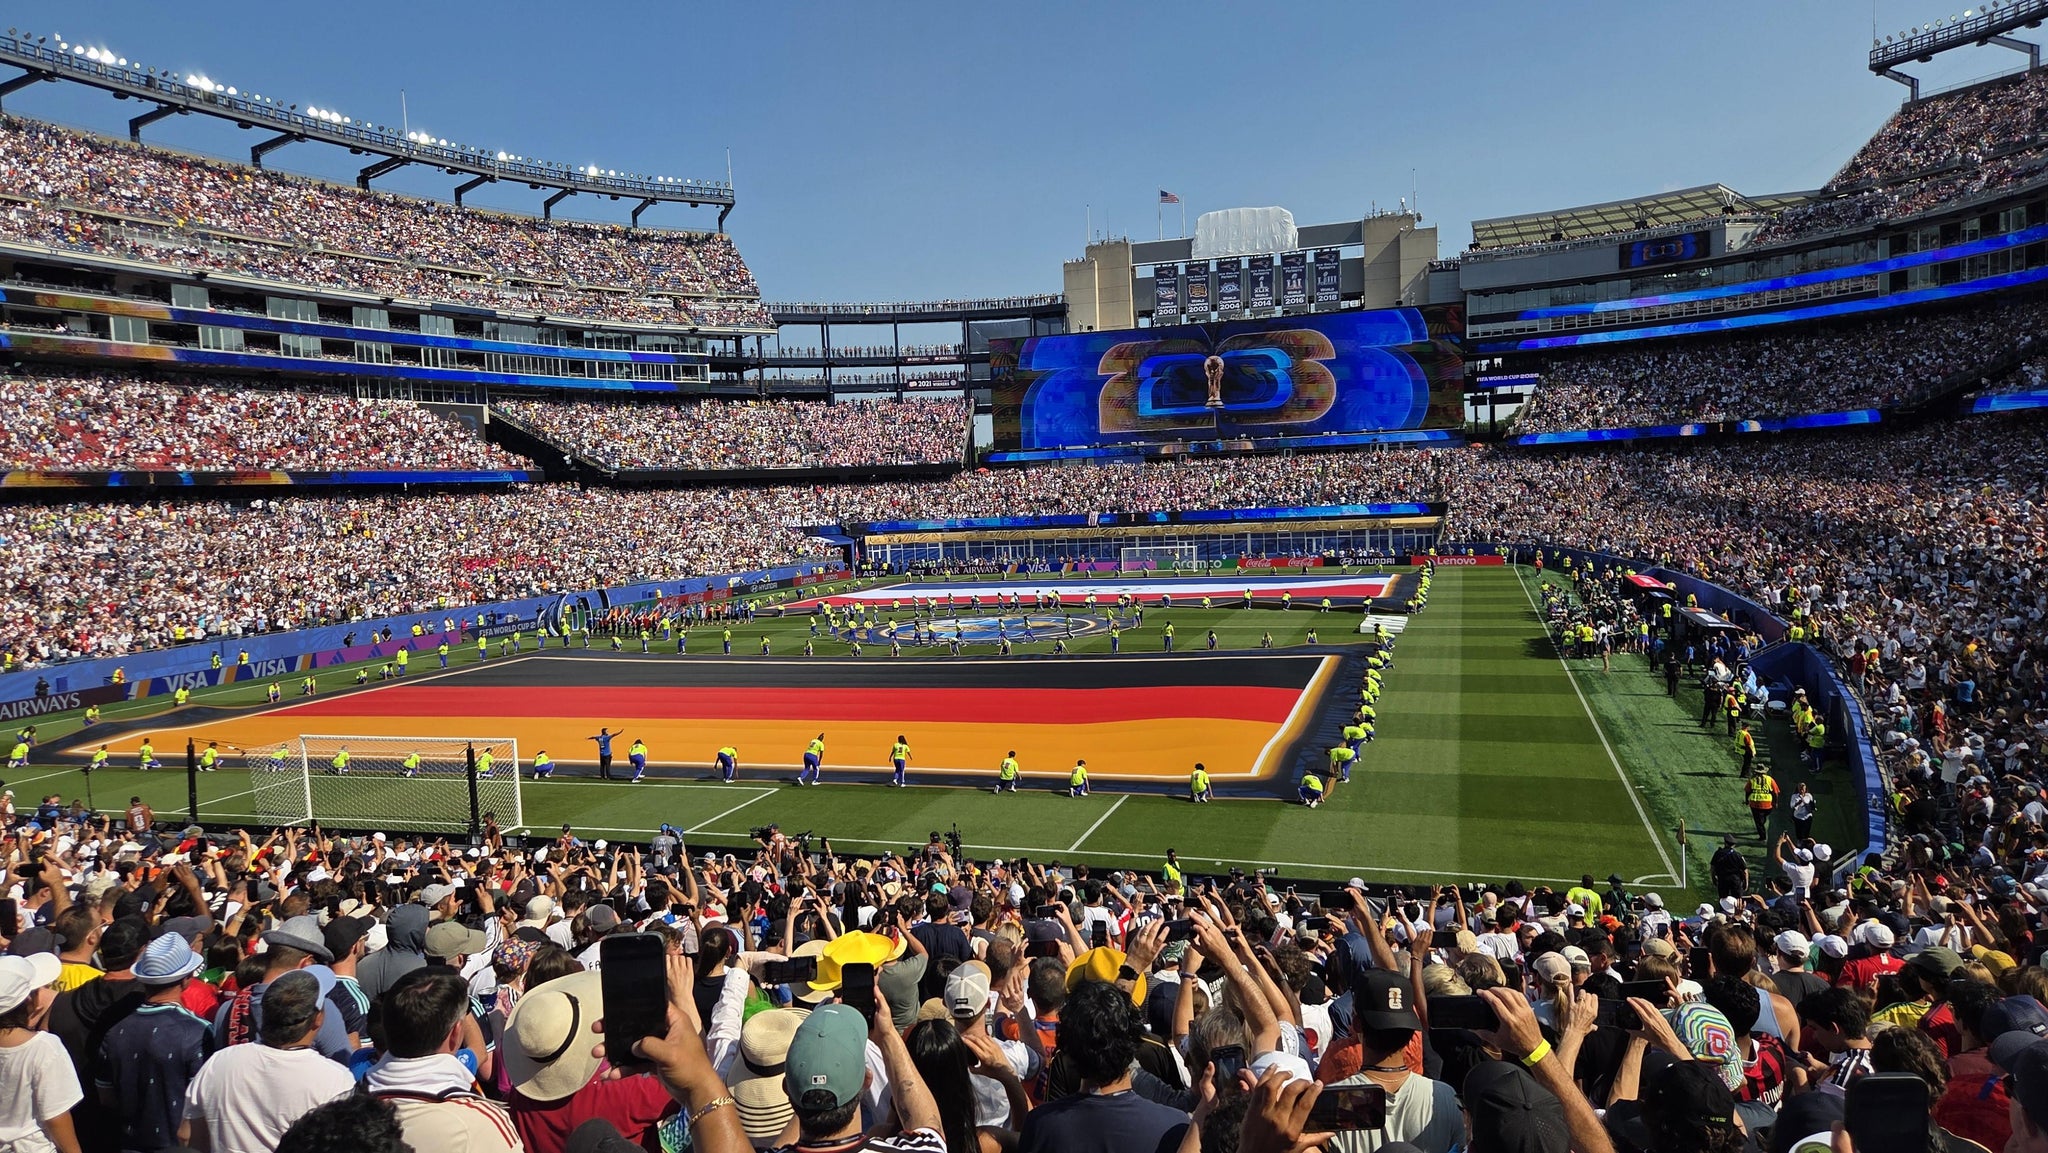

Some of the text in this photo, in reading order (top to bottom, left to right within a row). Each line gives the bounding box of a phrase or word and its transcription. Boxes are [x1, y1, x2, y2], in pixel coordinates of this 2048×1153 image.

[1437, 557, 1477, 565] Lenovo
[963, 566, 999, 574] AIRWAYS
[1028, 564, 1051, 573] VISA
[801, 576, 816, 585] Lenovo
[759, 582, 778, 590] HYUNDAI
[479, 628, 494, 636] FIFA
[494, 624, 517, 635] WORLD
[517, 622, 530, 630] CUP
[250, 659, 287, 678] VISA
[163, 671, 208, 692] VISA
[0, 692, 81, 720] AIRWAYS
